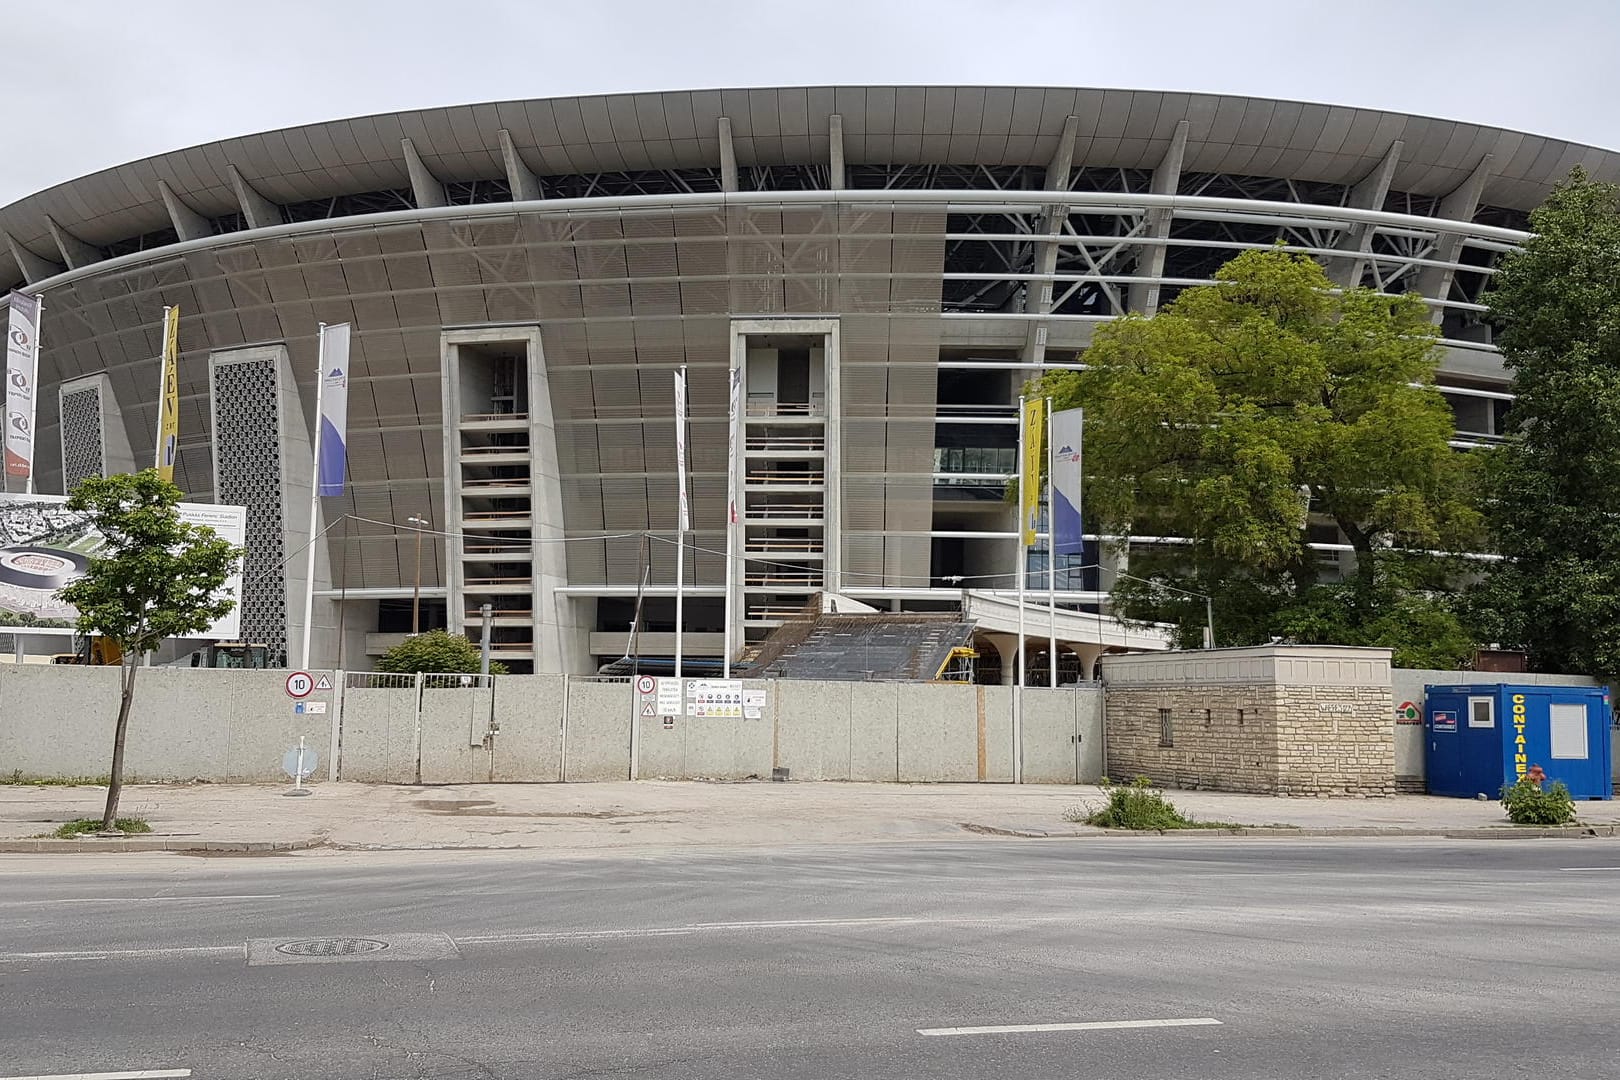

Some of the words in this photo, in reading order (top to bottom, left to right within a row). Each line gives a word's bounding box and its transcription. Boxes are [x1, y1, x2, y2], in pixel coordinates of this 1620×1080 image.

[294, 679, 305, 690] 10
[642, 680, 651, 689] 10
[1512, 694, 1527, 783] CONTAINEX
